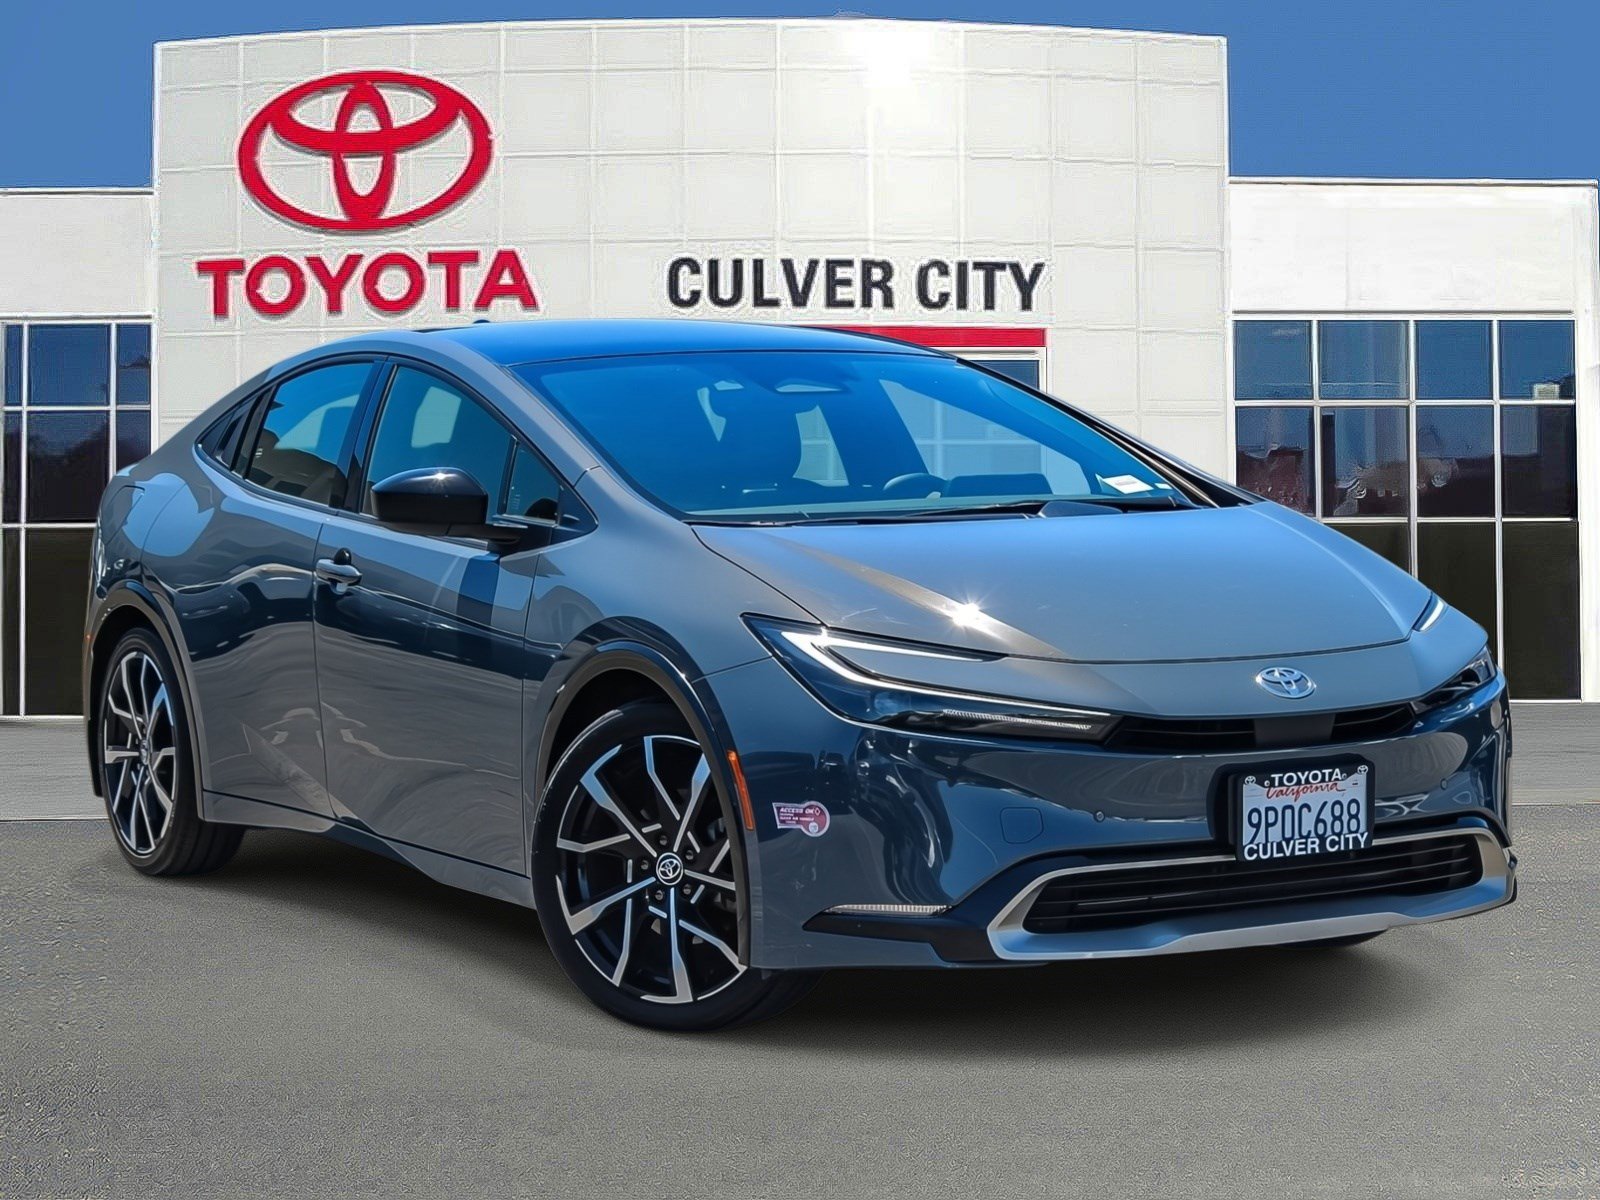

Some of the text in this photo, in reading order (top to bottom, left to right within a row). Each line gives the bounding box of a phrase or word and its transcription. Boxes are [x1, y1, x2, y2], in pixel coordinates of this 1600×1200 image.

[195, 250, 540, 319] TOYOTA
[668, 258, 1045, 311] CULVER CITY
[1266, 782, 1346, 802] California
[1271, 769, 1342, 787] TOYOTA
[1243, 832, 1369, 861] CULVER CITY
